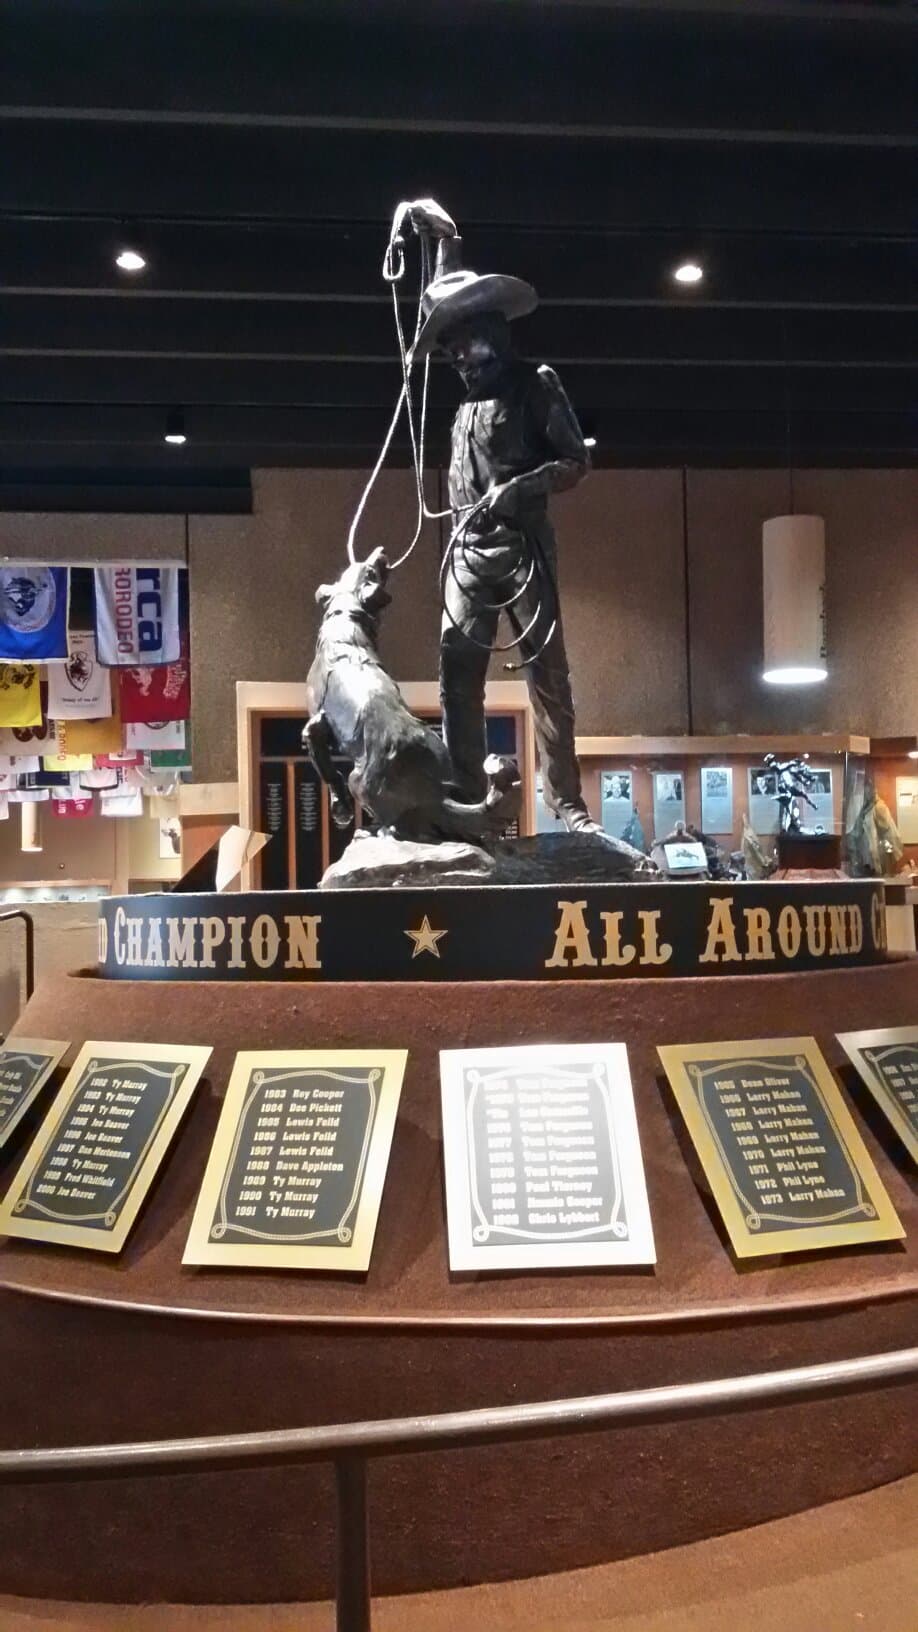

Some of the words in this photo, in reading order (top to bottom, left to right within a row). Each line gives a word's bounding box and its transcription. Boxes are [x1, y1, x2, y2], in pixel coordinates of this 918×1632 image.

[114, 906, 322, 969] CHAMPION
[545, 900, 673, 968] ALL
[700, 897, 863, 962] AROUND
[112, 1079, 121, 1089] Ty
[122, 1080, 147, 1091] Murray
[106, 1092, 115, 1102] Ty
[115, 1093, 141, 1104] Murray
[293, 1090, 311, 1100] Roy
[313, 1090, 344, 1099] Cooper
[746, 1093, 770, 1102] Larry
[99, 1105, 108, 1115] Ty
[109, 1106, 135, 1118] Murray
[261, 1104, 282, 1112] 1984
[290, 1104, 306, 1112] Dee
[310, 1104, 342, 1112] Pickett
[752, 1106, 776, 1115] Larry
[286, 1118, 313, 1126] Lewis
[758, 1120, 782, 1129] Larry
[283, 1132, 310, 1141] Lewis
[764, 1135, 789, 1143] Larry
[790, 1132, 820, 1140] Mahan
[250, 1147, 272, 1155] 1987
[279, 1147, 307, 1155] Lewis
[770, 1149, 795, 1157] Larry
[796, 1146, 826, 1154] Mahan
[72, 1159, 82, 1169] Ty
[82, 1160, 108, 1173] Murray
[276, 1161, 299, 1170] Dave
[301, 1162, 344, 1173] Appleton
[749, 1165, 769, 1175] 1971
[777, 1162, 795, 1172] Phil
[796, 1161, 818, 1171] Lyne
[64, 1172, 82, 1183] Fred
[273, 1176, 285, 1187] Ty
[288, 1177, 322, 1187] Murray
[755, 1179, 778, 1189] 1972
[783, 1177, 801, 1186] Phil
[802, 1176, 825, 1186] Lyne
[57, 1187, 70, 1195] Joe
[761, 1194, 783, 1205] 1973
[789, 1192, 814, 1201] Larry
[815, 1188, 845, 1198] Mahan
[239, 1191, 262, 1200] 1990
[269, 1192, 282, 1202] Ty
[284, 1192, 318, 1203] Murray
[236, 1207, 256, 1216] 1991
[266, 1207, 278, 1218] Ty
[281, 1207, 315, 1219] Murray
